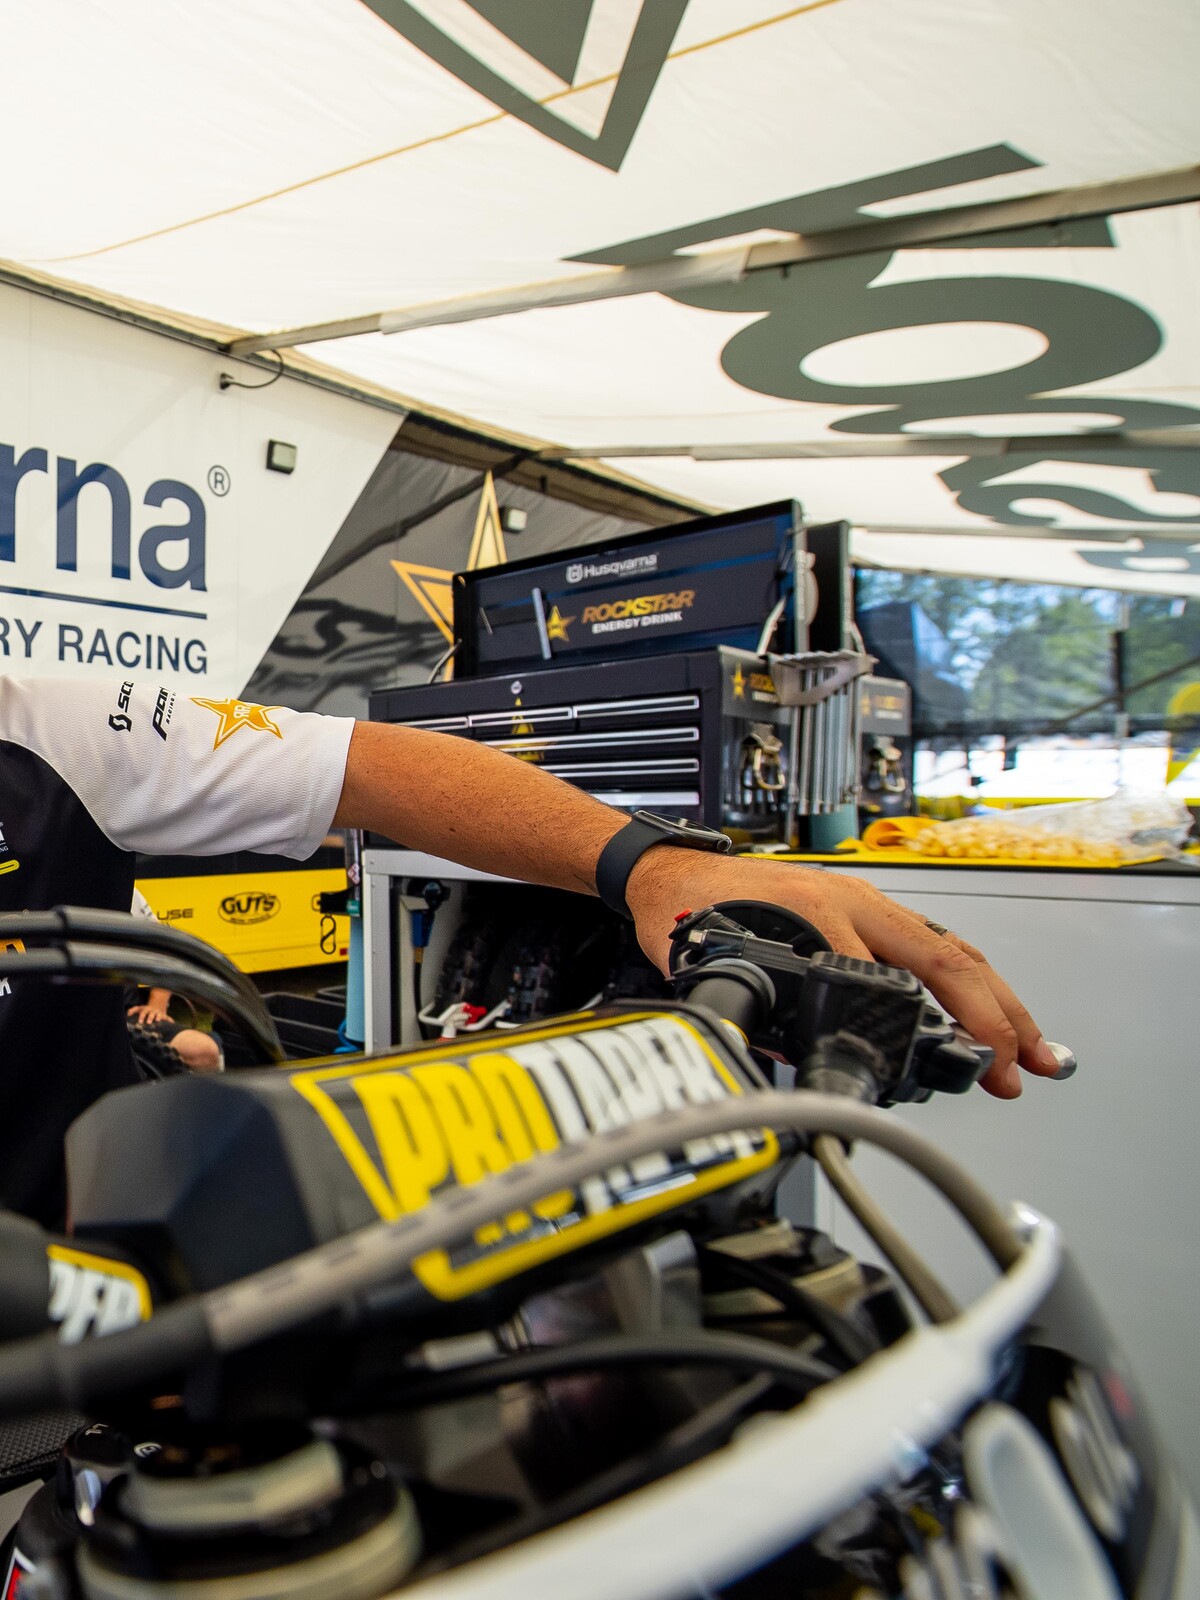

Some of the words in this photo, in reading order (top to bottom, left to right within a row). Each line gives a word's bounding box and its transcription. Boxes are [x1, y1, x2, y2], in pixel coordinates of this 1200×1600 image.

[584, 554, 657, 579] Husqvarna
[582, 589, 696, 624] ROCKSTAR
[591, 617, 640, 634] ENERGY
[640, 610, 683, 627] DRINK
[58, 623, 208, 675] RACING
[221, 895, 277, 915] GUTS
